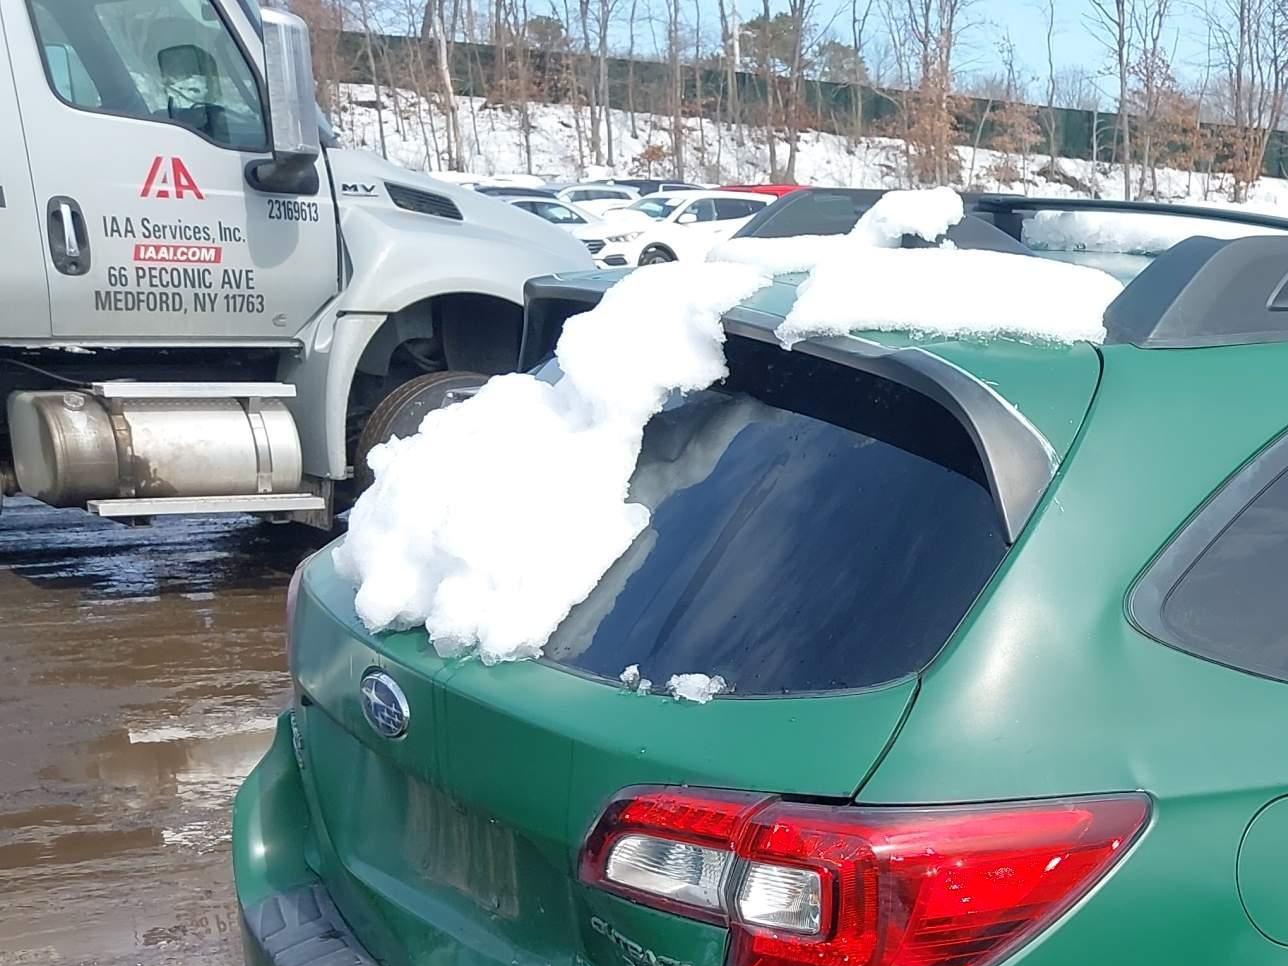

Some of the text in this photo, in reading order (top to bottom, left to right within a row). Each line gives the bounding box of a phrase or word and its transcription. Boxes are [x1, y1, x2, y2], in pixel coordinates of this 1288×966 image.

[341, 183, 376, 194] MV
[267, 199, 319, 223] 23169613
[103, 215, 246, 243] IAA Services, Inc.
[138, 245, 216, 262] IAAI.COM
[107, 266, 256, 291] 66 PECONIC AVE
[94, 290, 265, 314] MEDFORD, NY 11763
